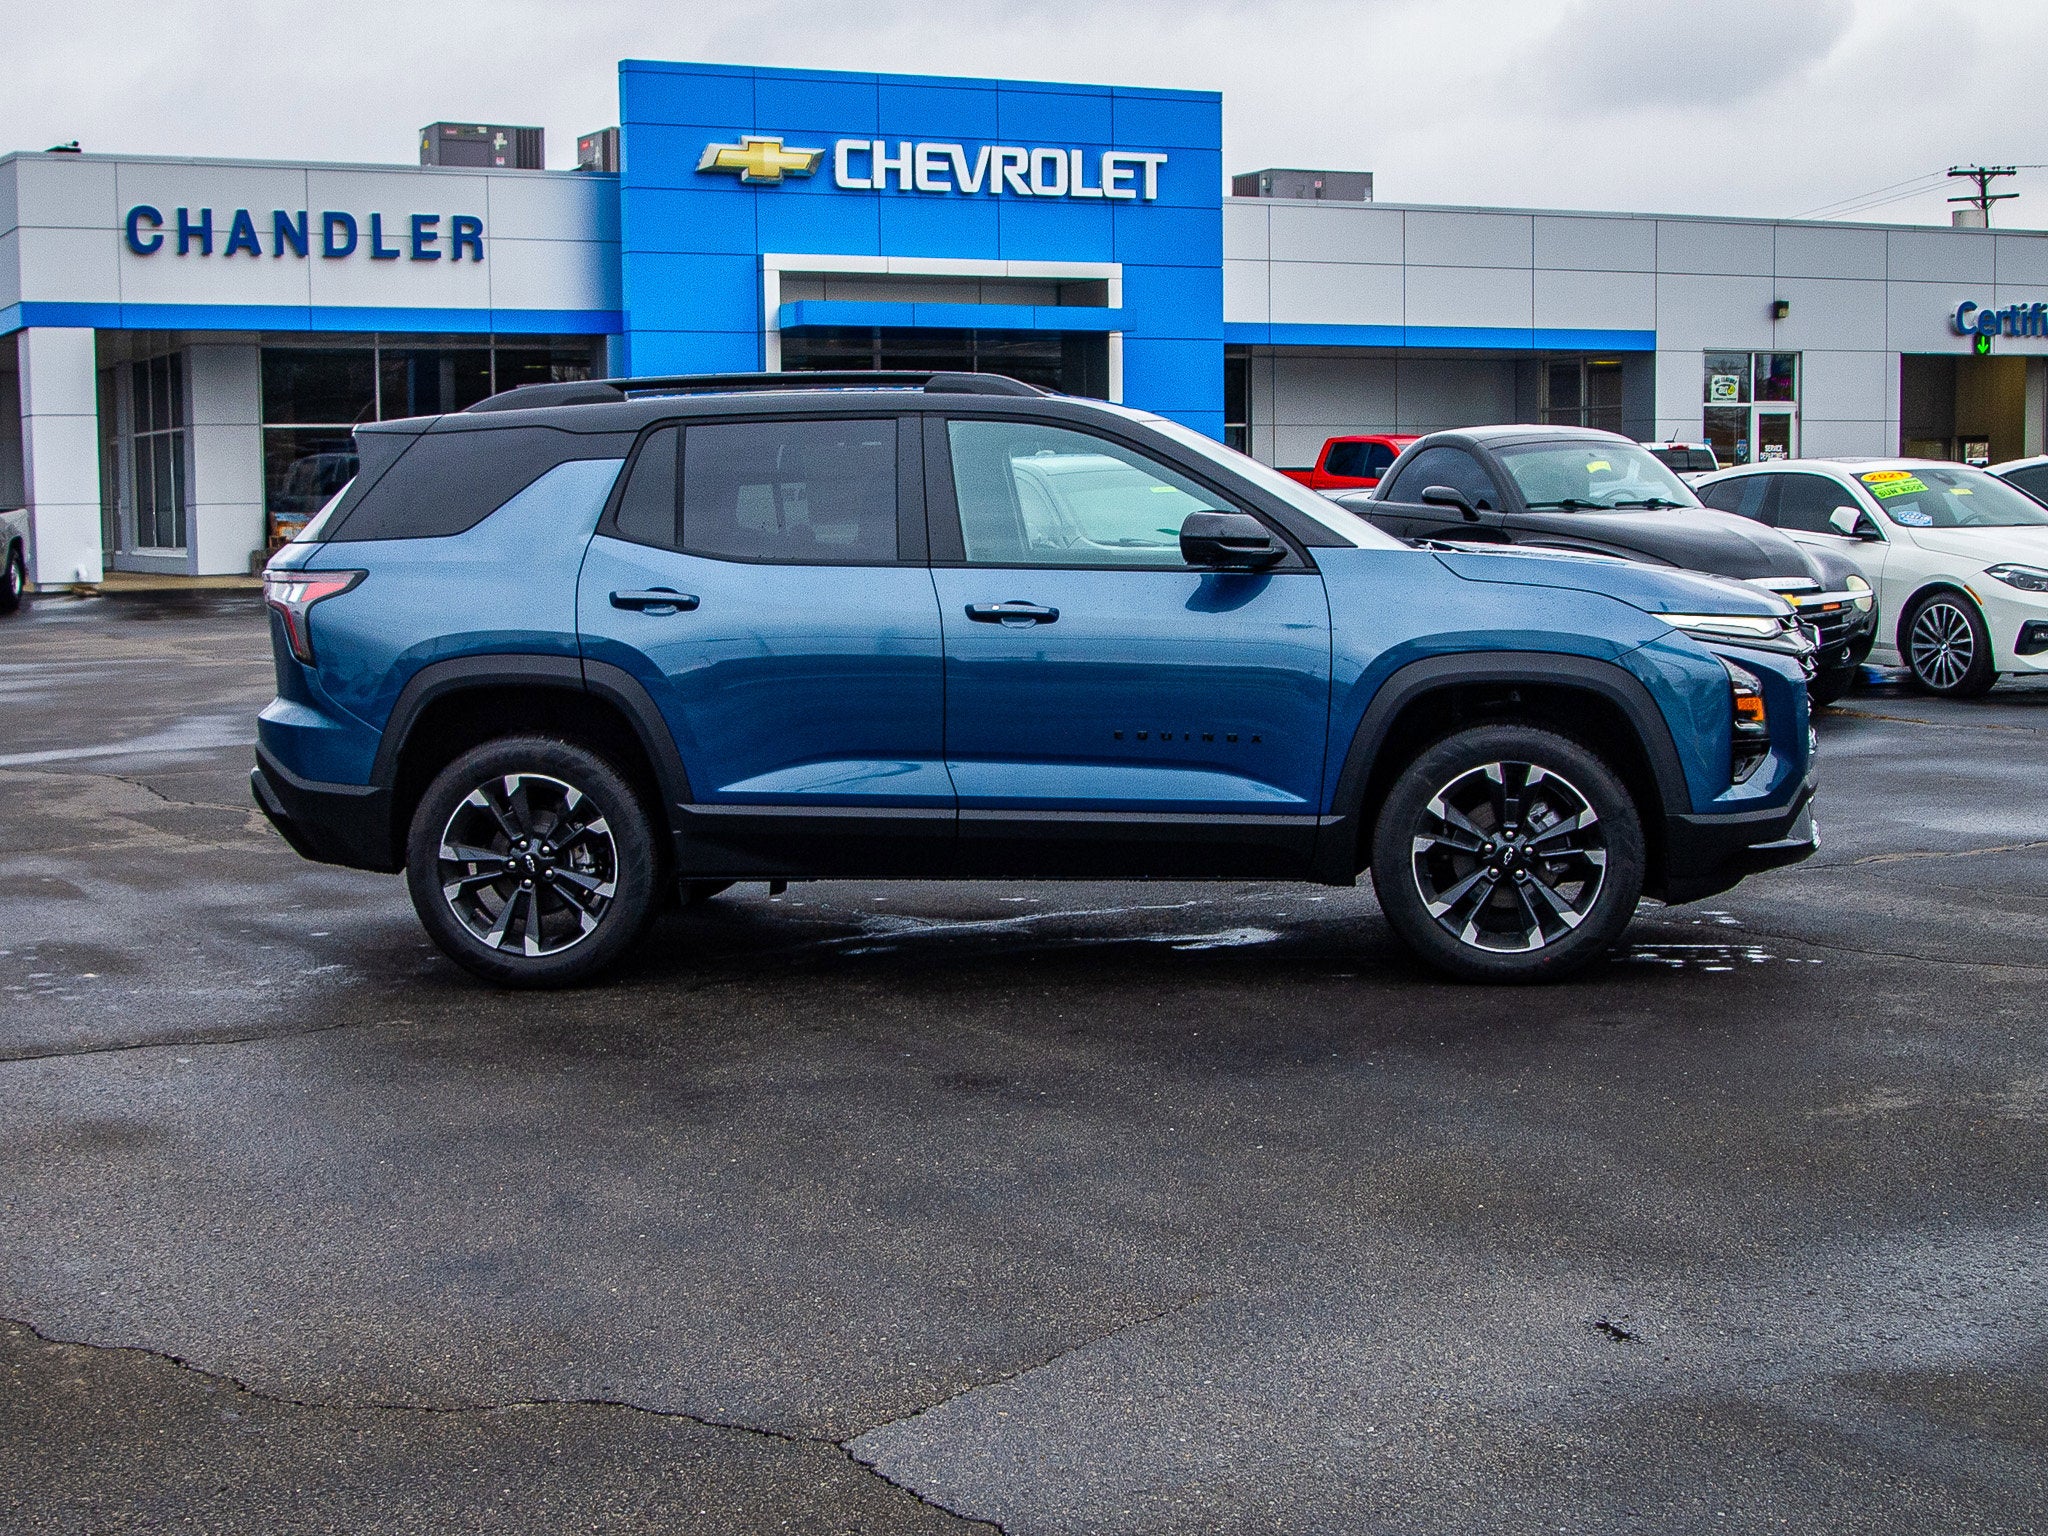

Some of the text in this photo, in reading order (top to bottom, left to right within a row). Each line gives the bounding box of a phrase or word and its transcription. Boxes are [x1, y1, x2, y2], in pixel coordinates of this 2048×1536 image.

[835, 139, 1168, 199] CHEVROLET
[126, 205, 484, 261] CHANDLER
[1955, 300, 2048, 336] Certifi
[1764, 444, 1783, 452] SERVICE
[1868, 472, 1904, 481] 2021
[1878, 484, 1924, 497] SUN ROOF
[1114, 730, 1262, 743] EQUINOX
